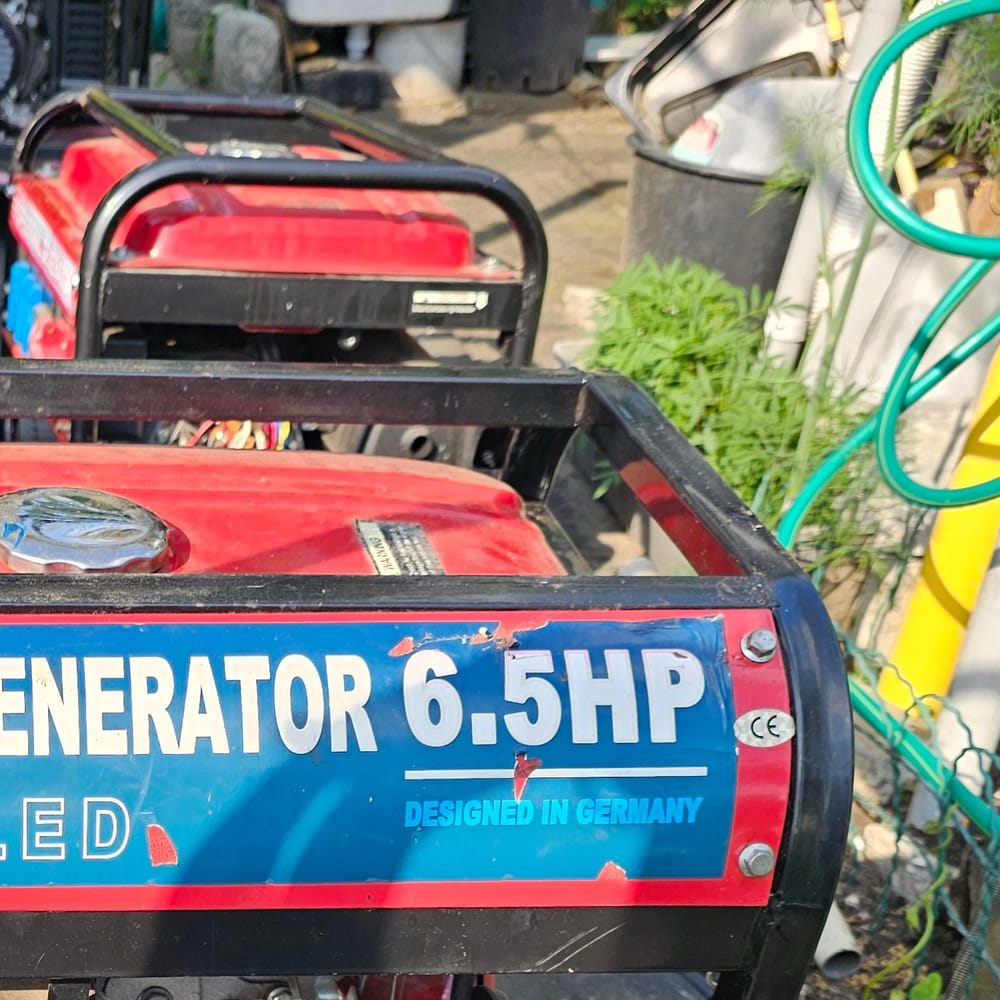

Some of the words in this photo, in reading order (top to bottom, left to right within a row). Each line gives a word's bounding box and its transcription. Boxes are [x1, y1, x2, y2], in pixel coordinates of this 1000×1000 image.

[403, 649, 706, 747] 6.5HP
[750, 714, 781, 739] CE
[404, 800, 535, 828] DESIGNED
[541, 799, 570, 825] IN
[575, 797, 704, 825] GERMANY
